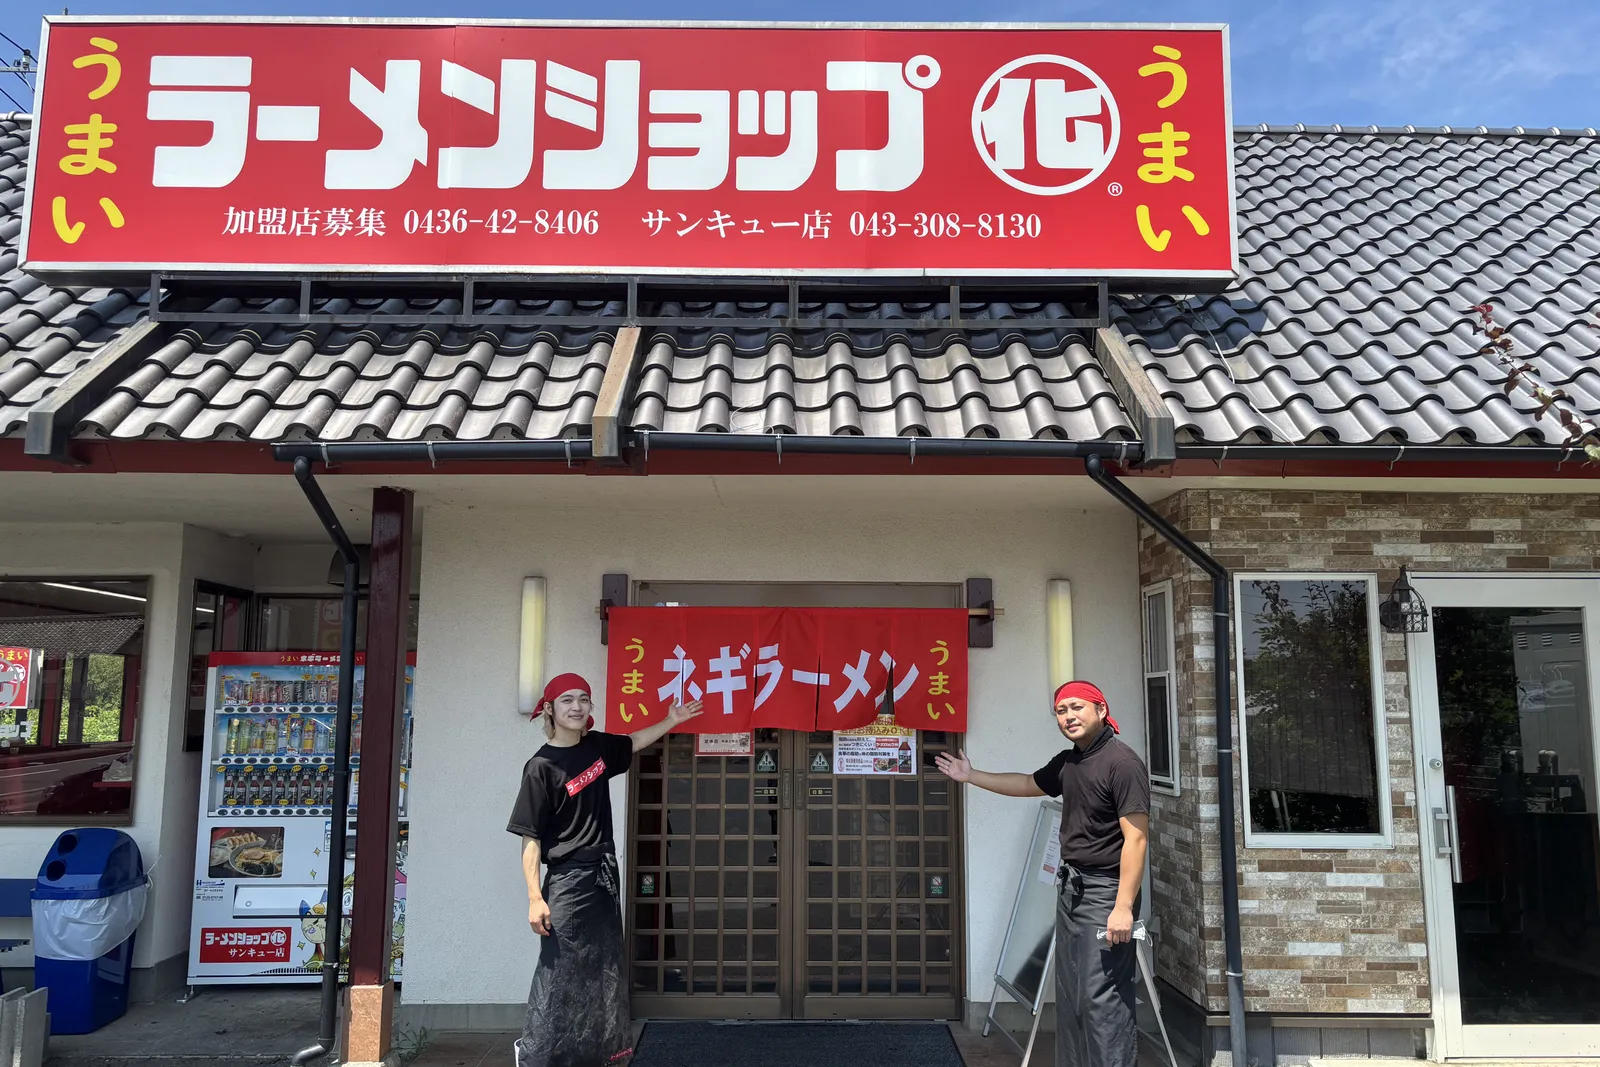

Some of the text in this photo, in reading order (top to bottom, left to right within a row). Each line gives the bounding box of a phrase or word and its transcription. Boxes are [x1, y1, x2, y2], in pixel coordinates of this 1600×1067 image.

[52, 37, 125, 244] うまい
[147, 54, 941, 192] ラーメンショップ
[1136, 46, 1210, 252] うまい
[222, 206, 599, 237] 加盟店募集 0436-42-8406
[642, 208, 1042, 240] サンキュー店 043-308-8130
[620, 638, 649, 723] うまい
[657, 643, 920, 714] ネギラーメン
[928, 640, 955, 720] うまい
[205, 932, 271, 946] ラーメンショップ
[228, 947, 285, 958] サンキュー店
